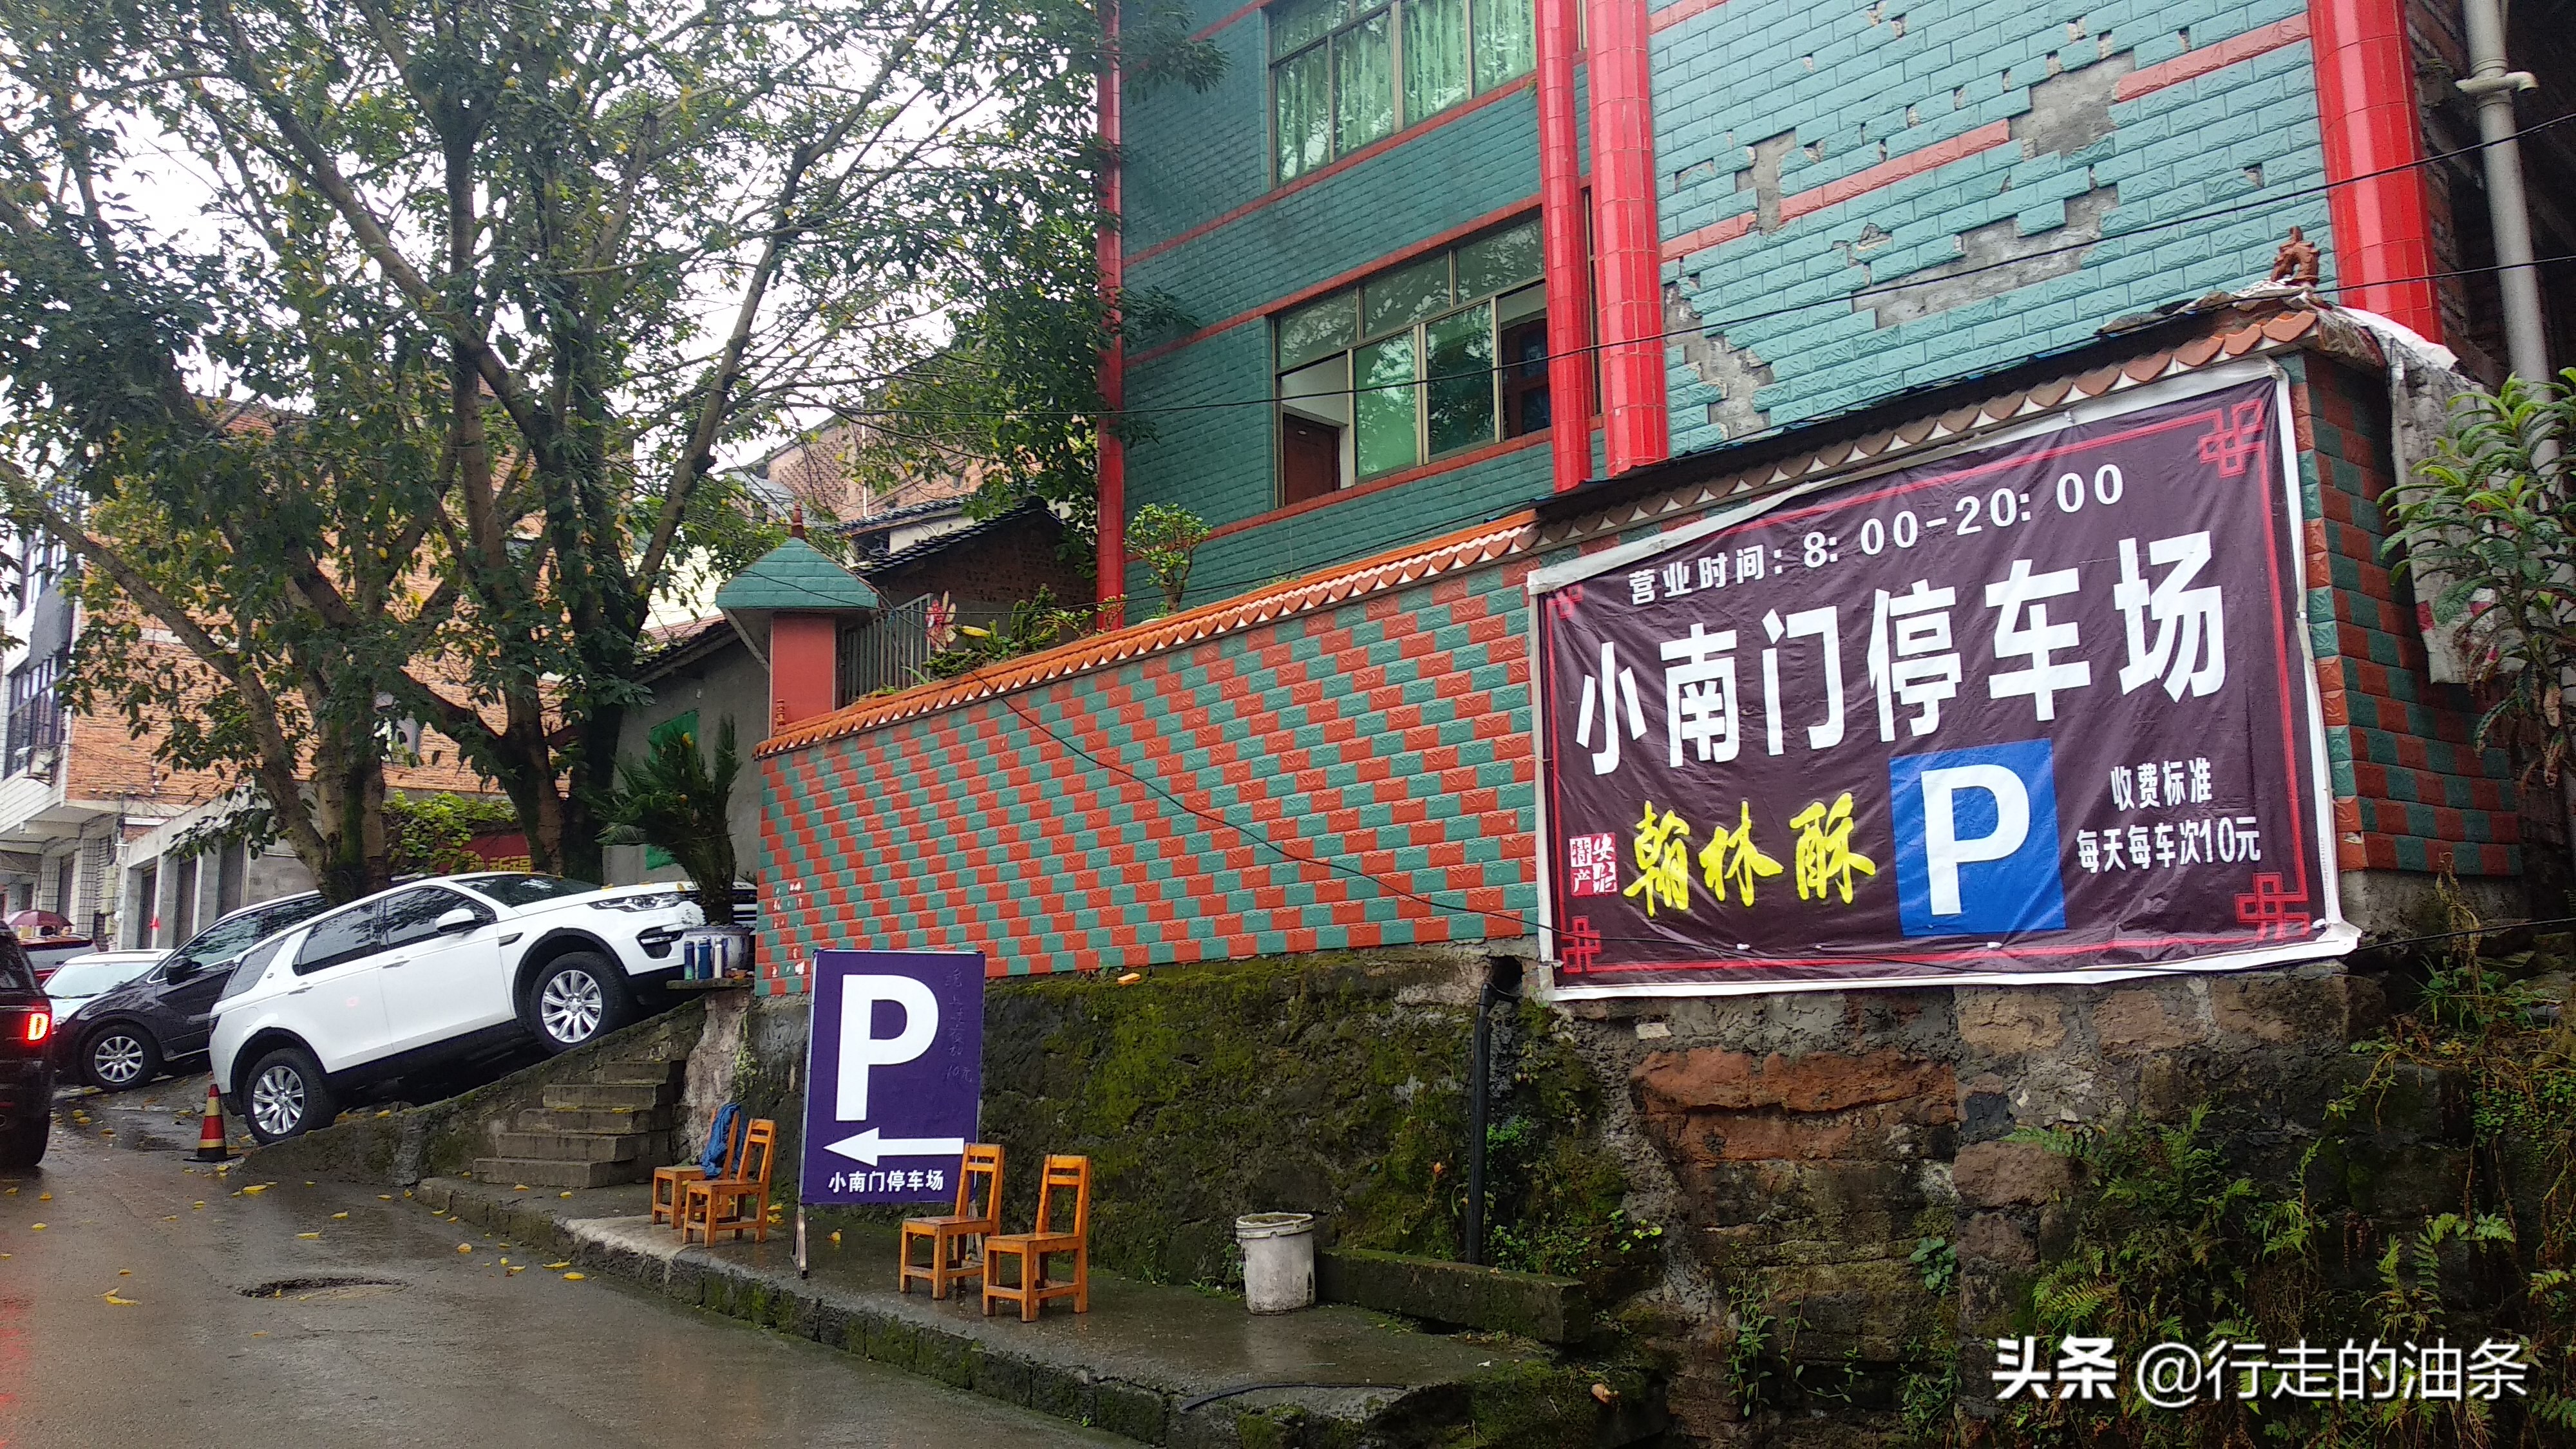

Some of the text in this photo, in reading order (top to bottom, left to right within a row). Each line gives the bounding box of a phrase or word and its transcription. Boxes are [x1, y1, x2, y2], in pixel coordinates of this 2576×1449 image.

[1575, 530, 2226, 776] 小南门停车场
[2110, 757, 2213, 811] 收费标准
[1920, 764, 2031, 916] P
[2076, 816, 2262, 873] 每天每车次10元
[835, 974, 940, 1121] P
[828, 1169, 945, 1193] 小南门停车场
